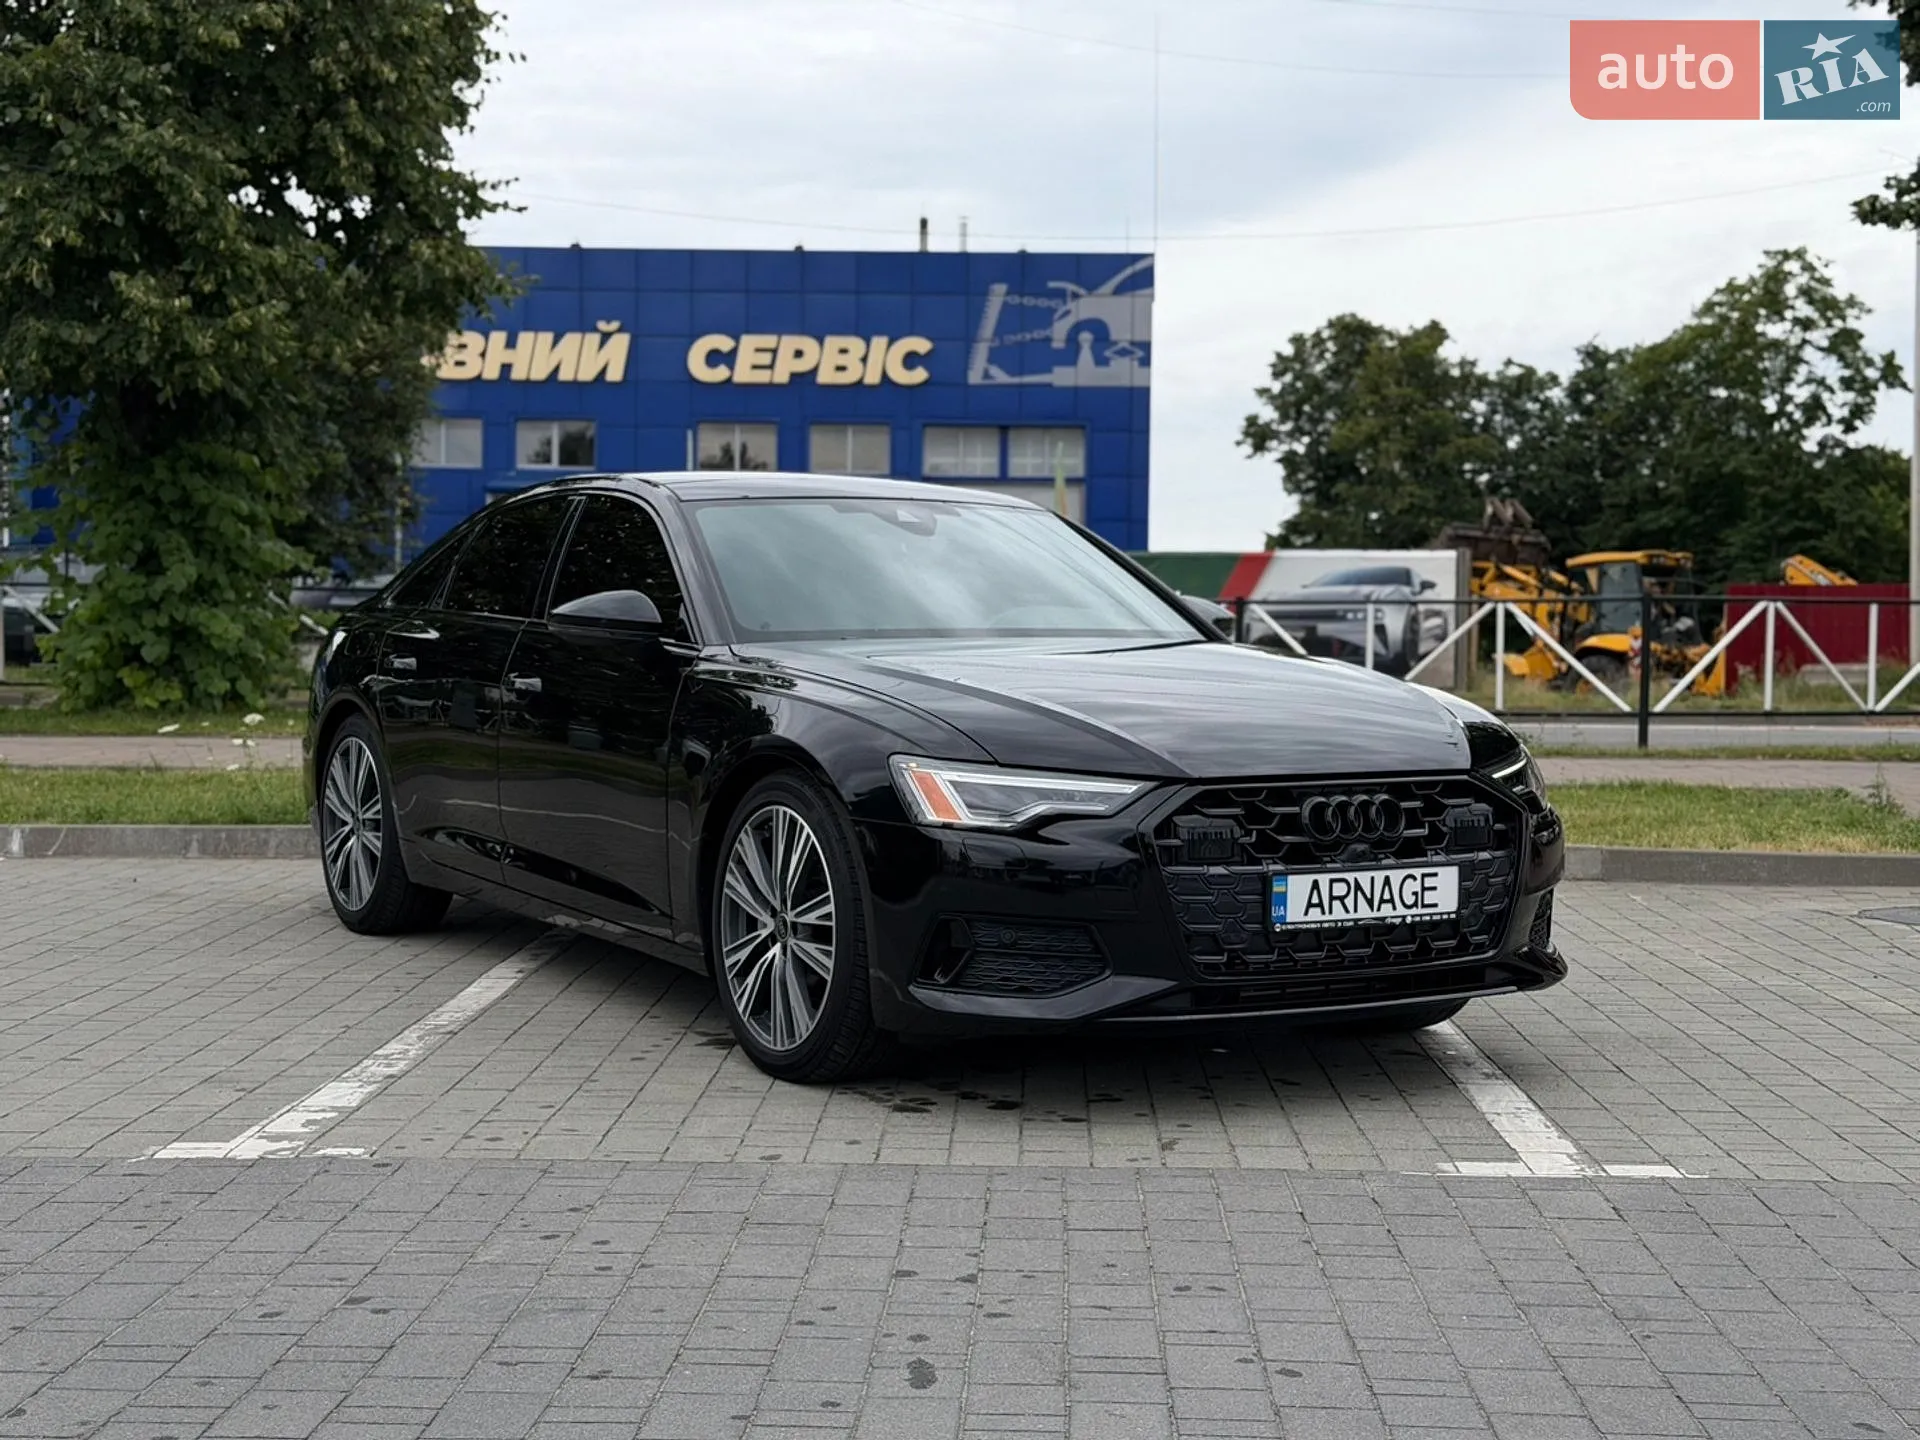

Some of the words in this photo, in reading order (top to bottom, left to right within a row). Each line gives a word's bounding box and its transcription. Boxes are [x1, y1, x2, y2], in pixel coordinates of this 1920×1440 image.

[420, 320, 631, 382] ВНИЙ
[687, 333, 934, 385] СЕРВІС
[1271, 904, 1286, 917] UA
[1303, 872, 1439, 917] ARNAGE
